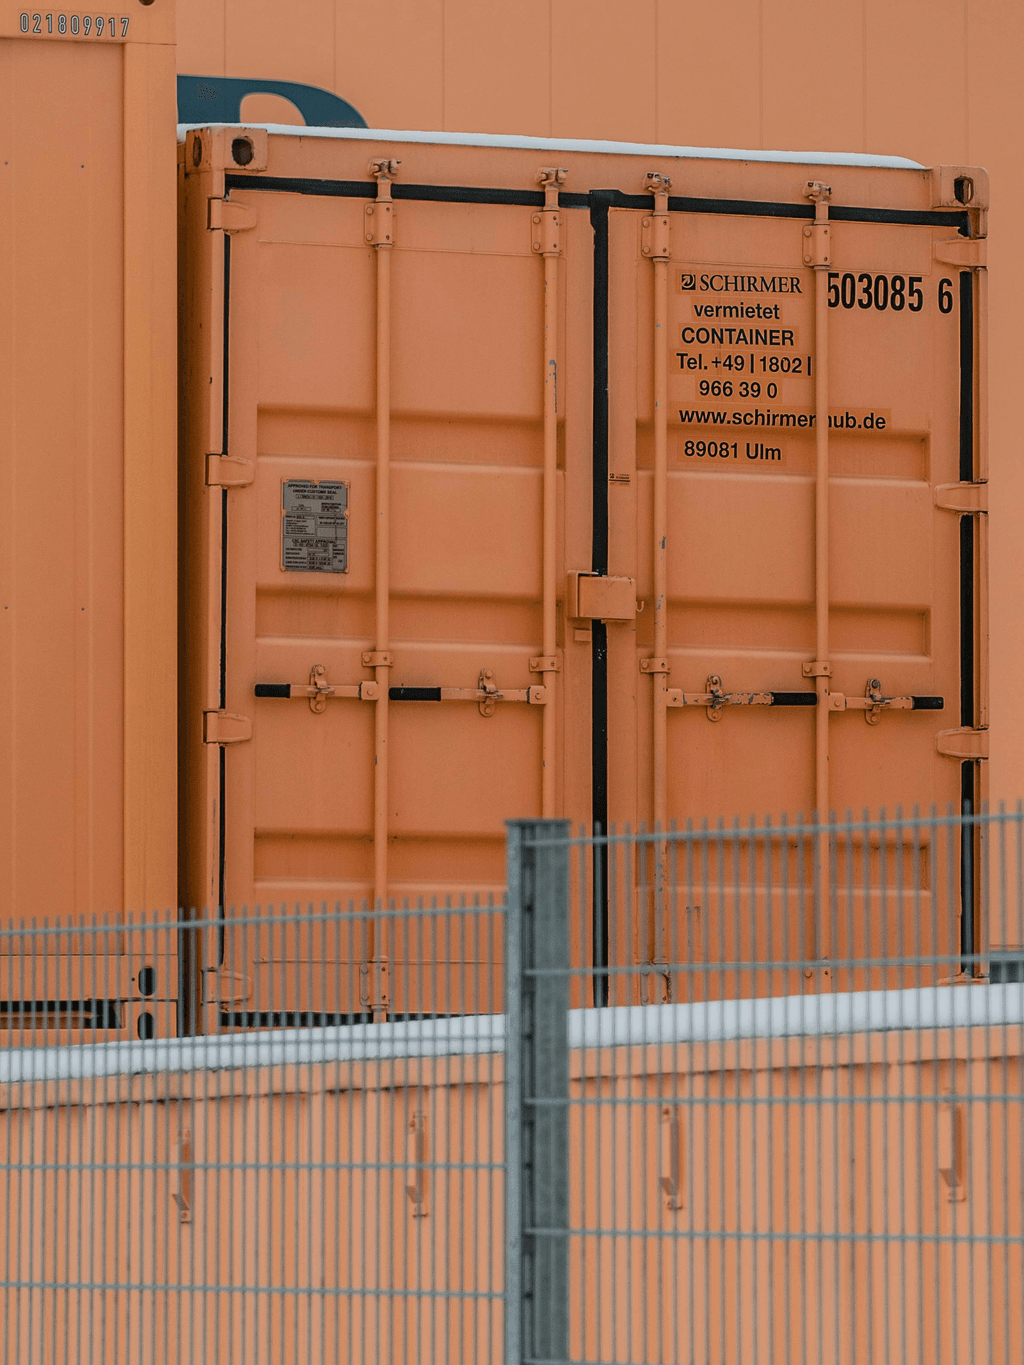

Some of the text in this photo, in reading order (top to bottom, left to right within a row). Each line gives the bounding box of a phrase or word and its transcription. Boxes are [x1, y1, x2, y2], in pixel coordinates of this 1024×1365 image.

[20, 12, 130, 37] 021809917
[699, 274, 803, 294] SCHIRMER
[827, 272, 953, 314] 503085 6
[694, 302, 780, 320] vermietet
[681, 327, 794, 346] CONTAINER
[759, 356, 802, 374] 1802
[699, 380, 778, 399] 966 39 0
[684, 440, 782, 460] 89081 Ulm
